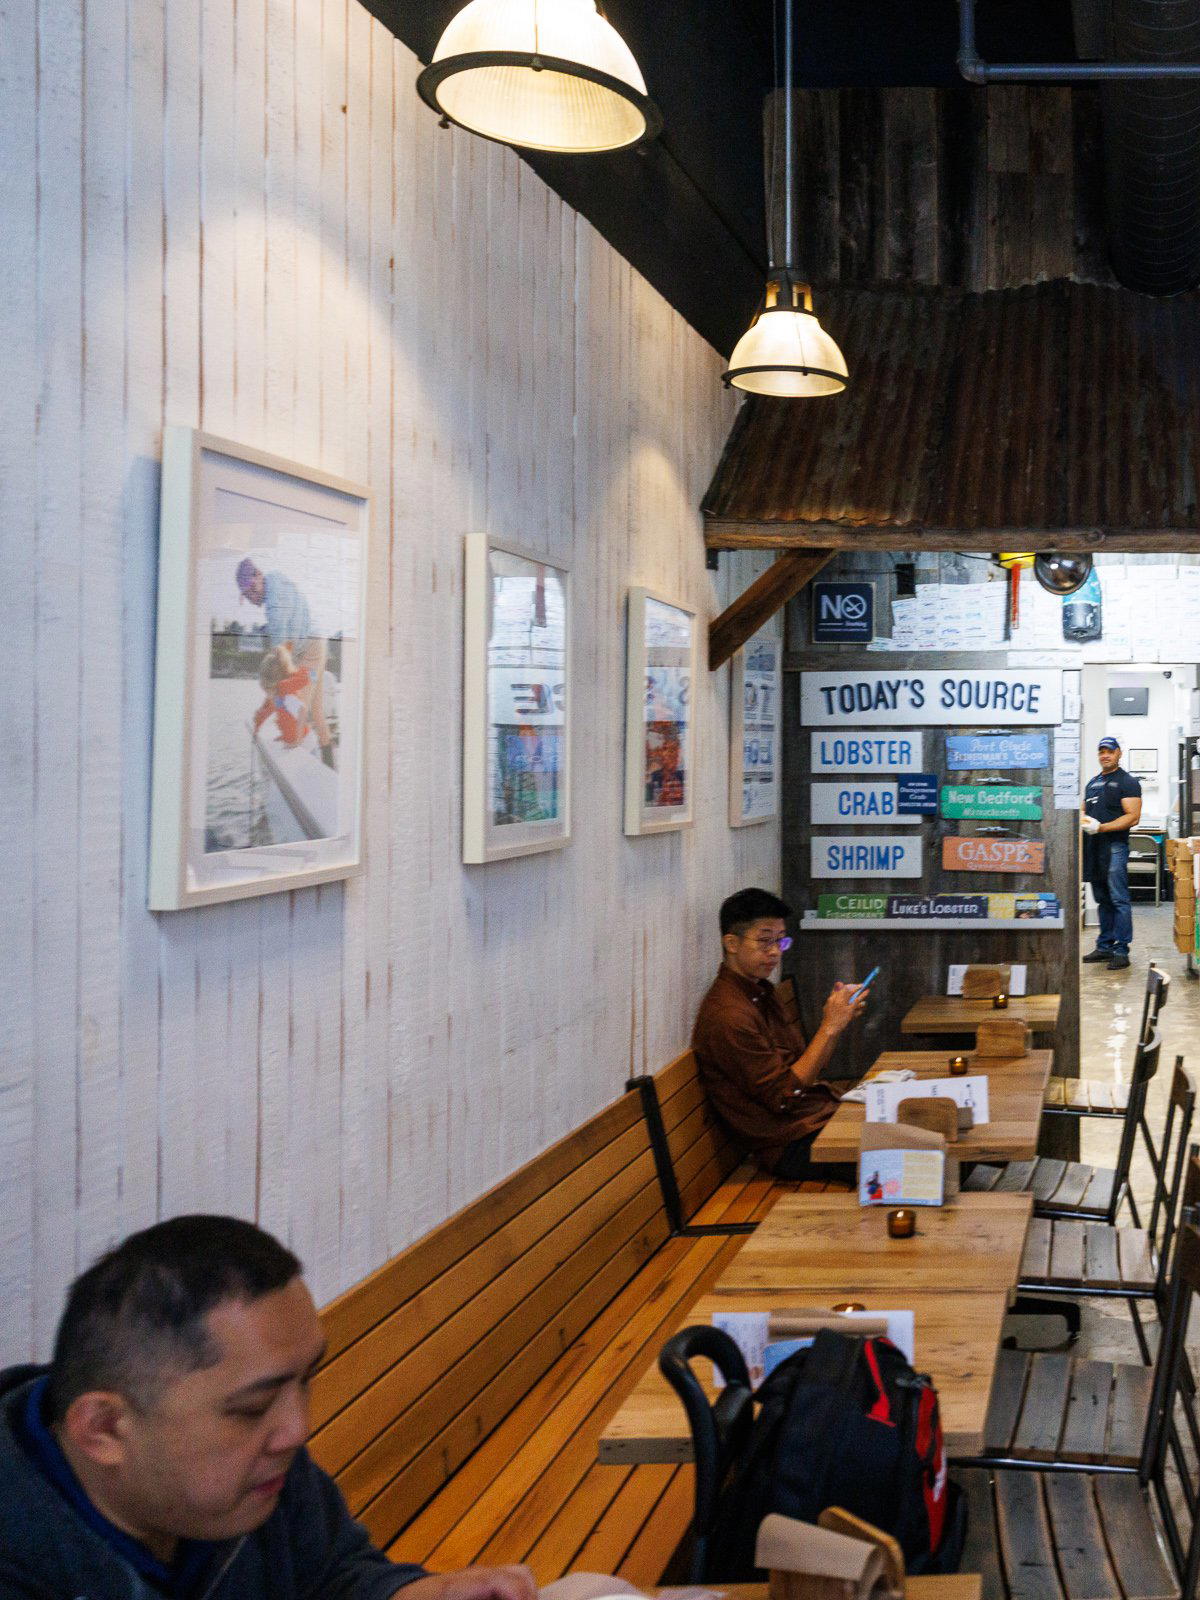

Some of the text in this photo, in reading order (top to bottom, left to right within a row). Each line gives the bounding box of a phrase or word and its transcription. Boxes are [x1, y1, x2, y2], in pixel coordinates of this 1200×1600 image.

[820, 679, 1041, 715] TODAY'S SOURCE
[821, 740, 911, 765] LOBSTER
[838, 791, 894, 816] CRAB
[948, 790, 1034, 804] New Bedford
[827, 845, 904, 871] SHRIMP
[892, 901, 928, 915] LUKE'S
[929, 901, 978, 915] LOBSTER
